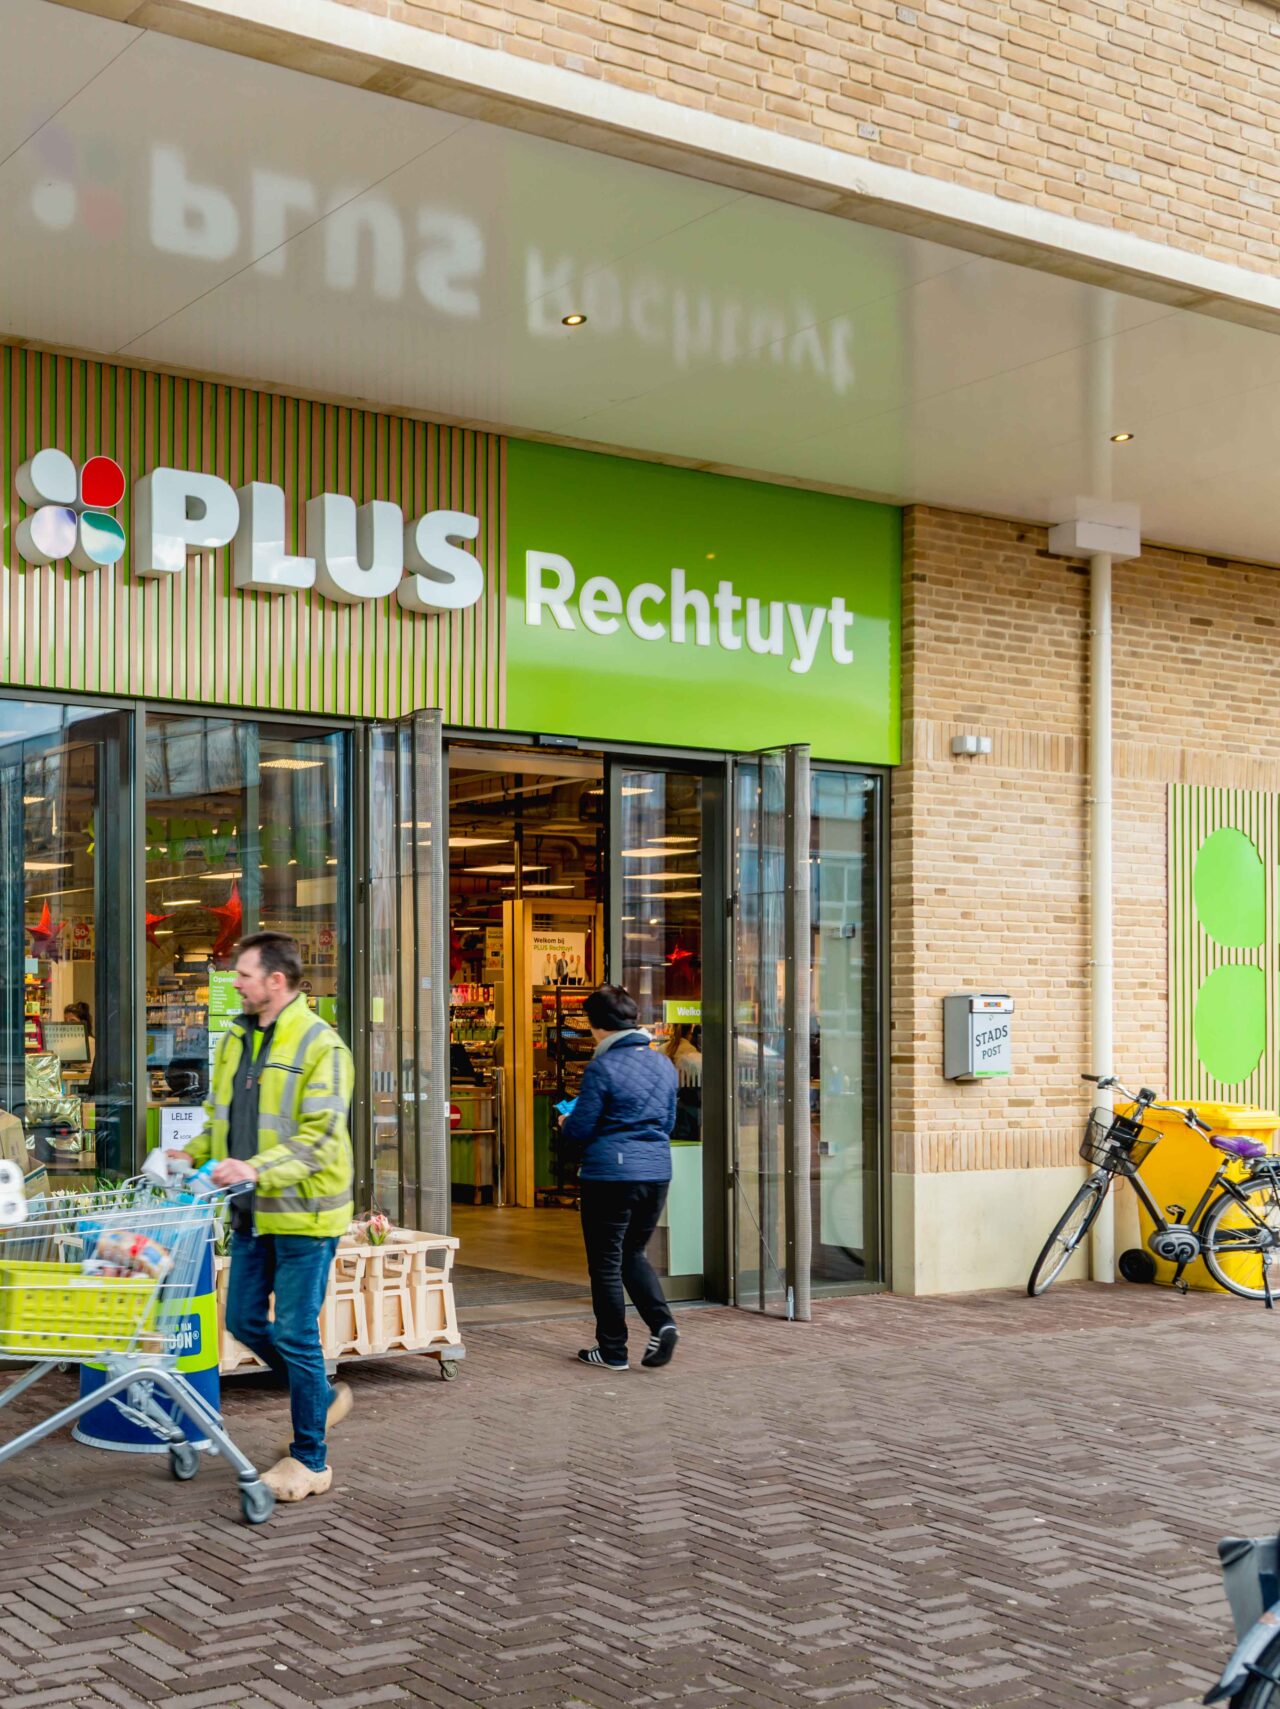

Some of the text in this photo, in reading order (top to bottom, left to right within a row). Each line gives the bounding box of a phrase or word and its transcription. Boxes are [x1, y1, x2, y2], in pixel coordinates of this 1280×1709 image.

[135, 466, 484, 615] PLUS
[525, 550, 854, 674] Rechtuyt
[557, 937, 565, 945] bij
[677, 1007, 702, 1016] Welko
[975, 1024, 1008, 1047] STADS
[982, 1044, 1002, 1060] POST
[171, 1112, 193, 1121] LELIE
[173, 1130, 179, 1140] 2
